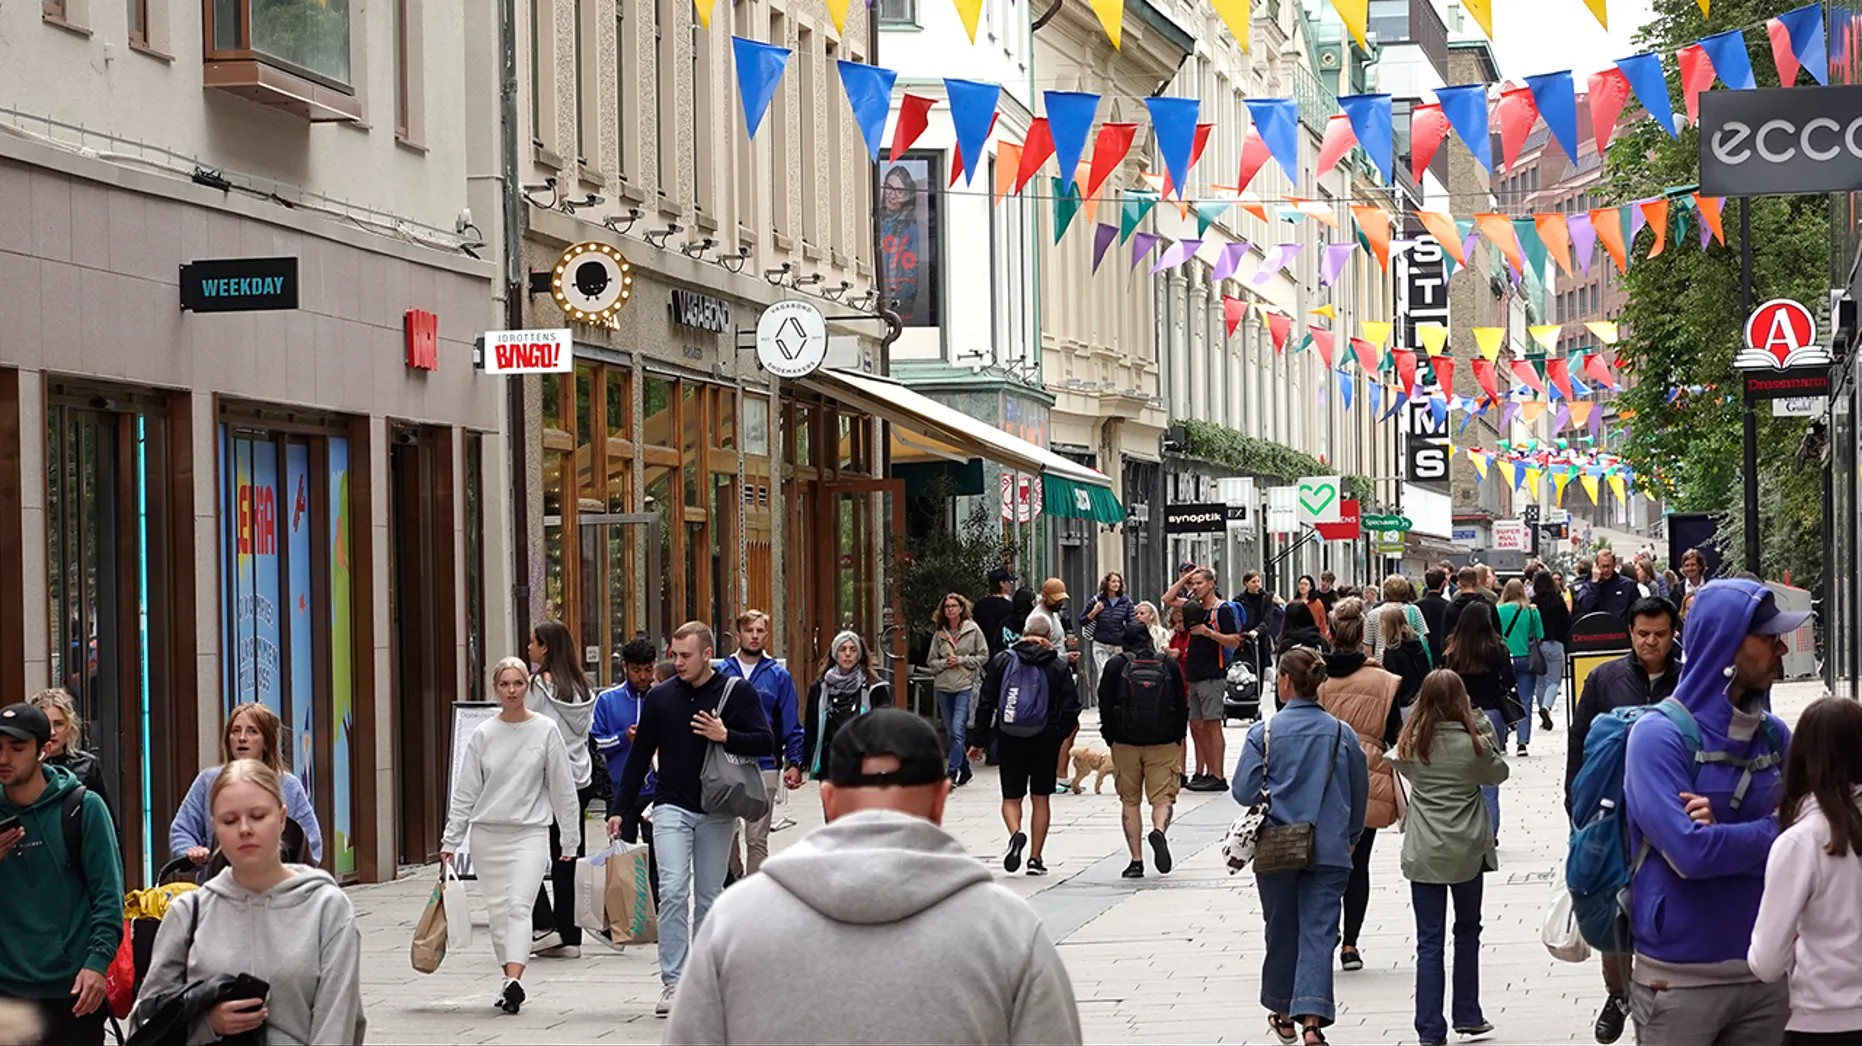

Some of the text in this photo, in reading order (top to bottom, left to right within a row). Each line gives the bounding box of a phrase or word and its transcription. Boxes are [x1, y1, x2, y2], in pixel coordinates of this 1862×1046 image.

[202, 276, 284, 297] WEEKDAY
[771, 303, 812, 314] VAGABOND
[1764, 307, 1800, 351] A
[498, 332, 557, 342] IDROTTENS
[495, 343, 561, 369] BINGO!
[767, 360, 816, 373] SHOEMAKERS
[1748, 377, 1827, 391] Dressmann
[1168, 513, 1221, 524] synoptik
